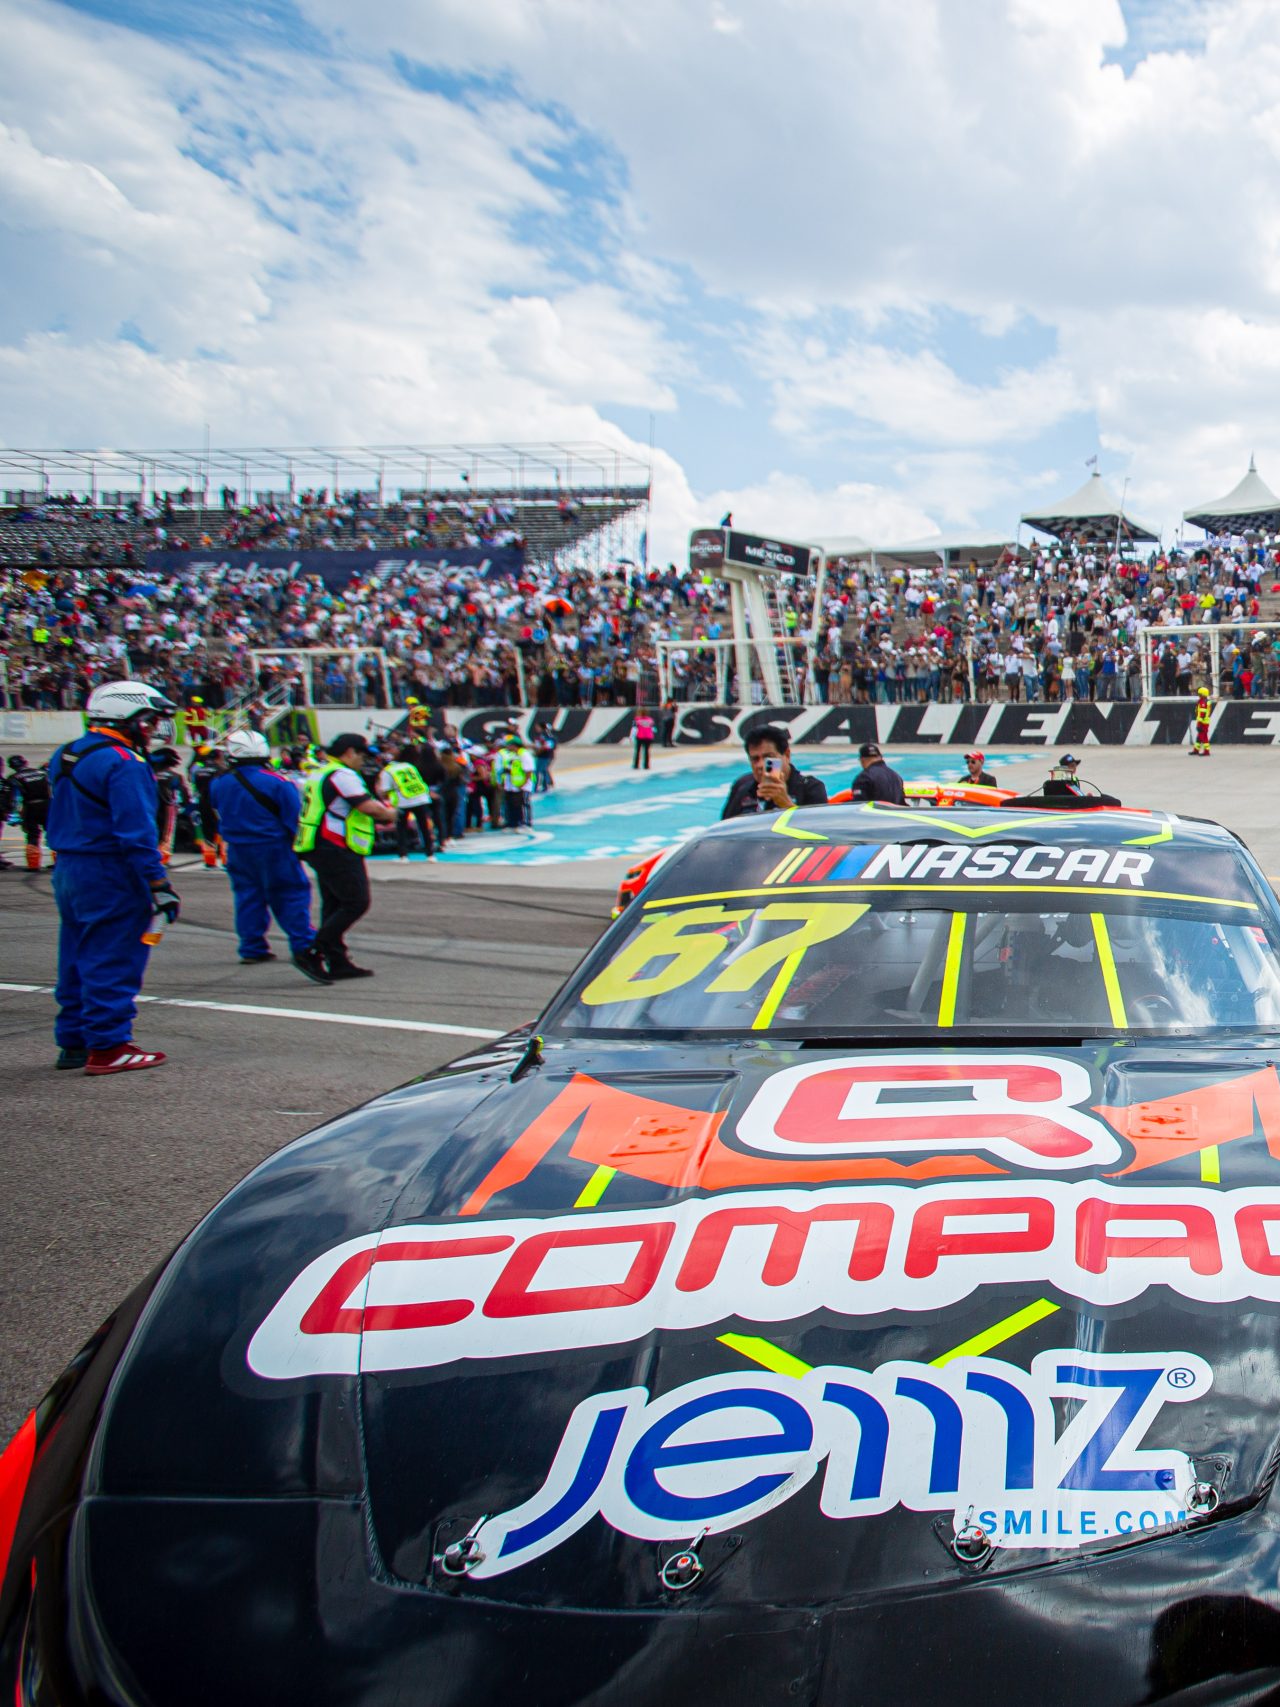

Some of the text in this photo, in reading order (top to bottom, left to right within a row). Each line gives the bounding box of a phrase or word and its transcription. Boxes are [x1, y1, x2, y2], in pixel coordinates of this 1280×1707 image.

[860, 843, 1155, 887] NASCAR
[580, 902, 872, 1005] 67
[978, 1509, 1188, 1535] SMILE.COM
